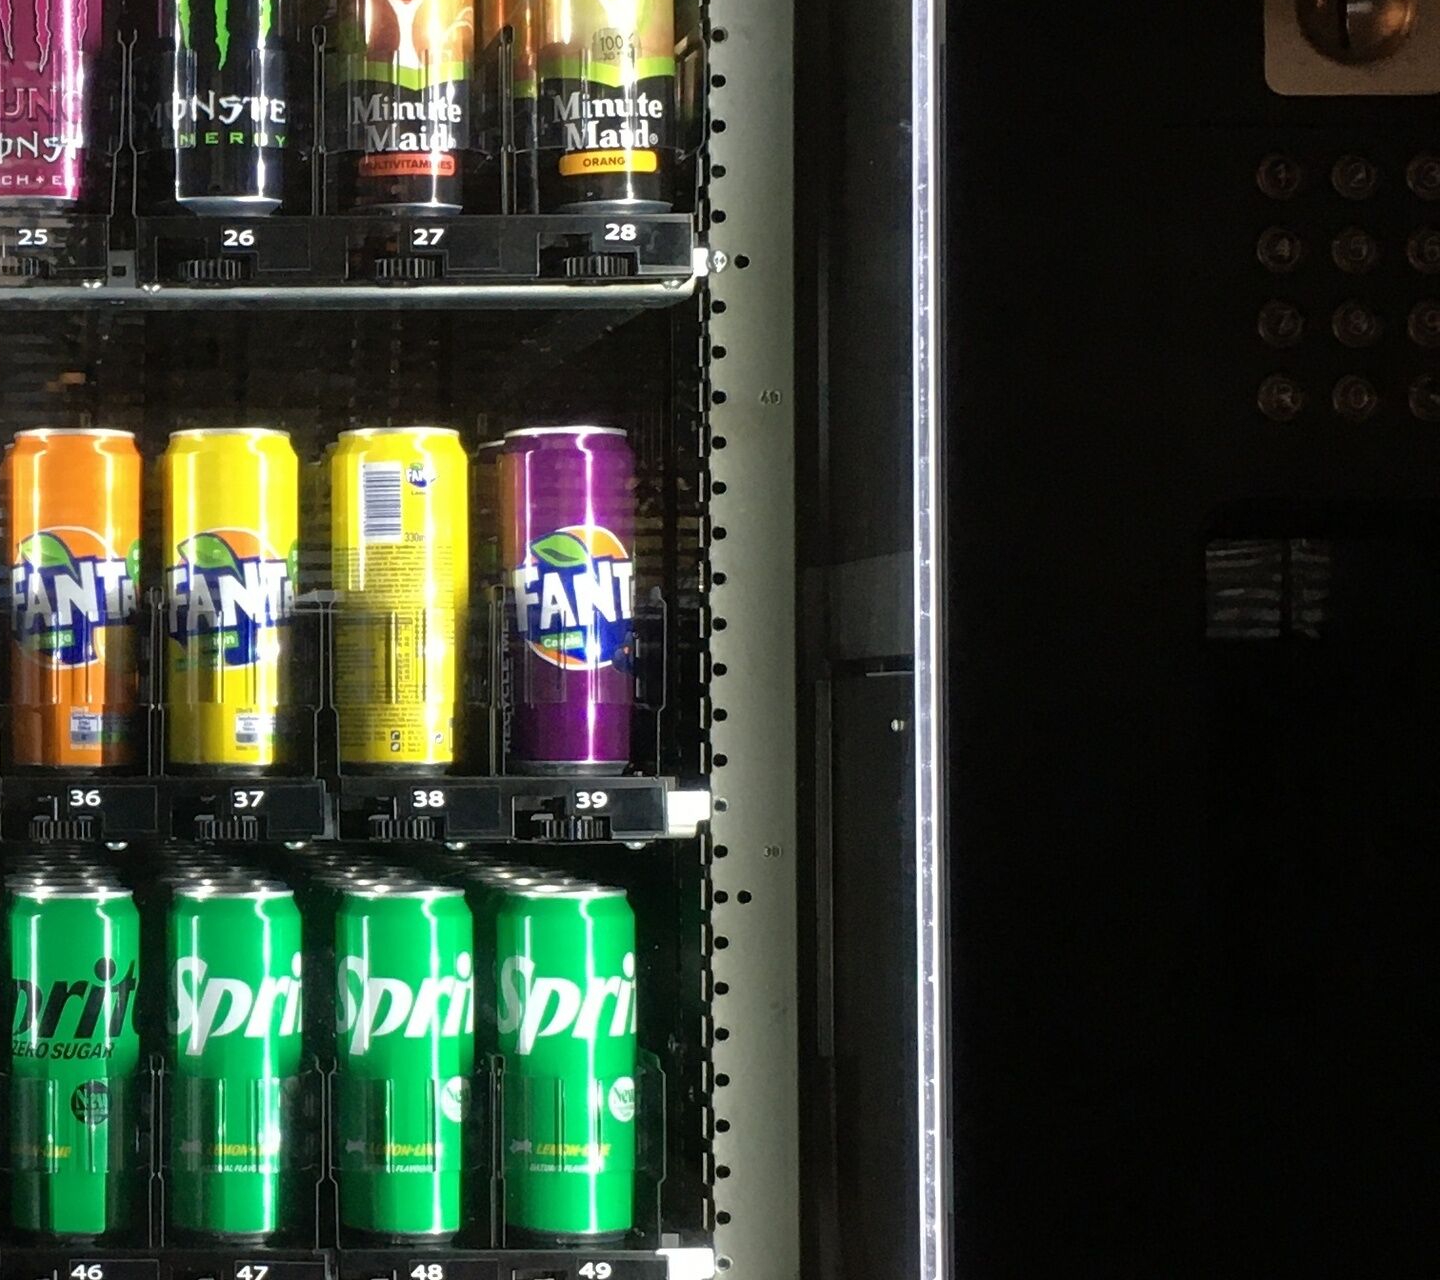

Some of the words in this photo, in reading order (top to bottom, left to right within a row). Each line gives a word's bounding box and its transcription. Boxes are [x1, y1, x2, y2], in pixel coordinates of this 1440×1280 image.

[353, 93, 462, 124] Minute
[554, 91, 663, 121] Minute
[365, 122, 450, 152] Maid
[565, 122, 650, 152] Maid
[582, 155, 628, 168] ORANG
[18, 228, 48, 246] 25
[223, 229, 255, 246] 26
[413, 228, 445, 246] 27
[604, 223, 637, 241] 28
[514, 560, 636, 632] FANT
[70, 789, 101, 807] 36
[233, 790, 265, 808] 37
[413, 790, 445, 808] 38
[575, 791, 608, 809] 39
[51, 1040, 115, 1059] SUGAR
[70, 1264, 103, 1280] 46
[578, 1262, 612, 1280] 49
